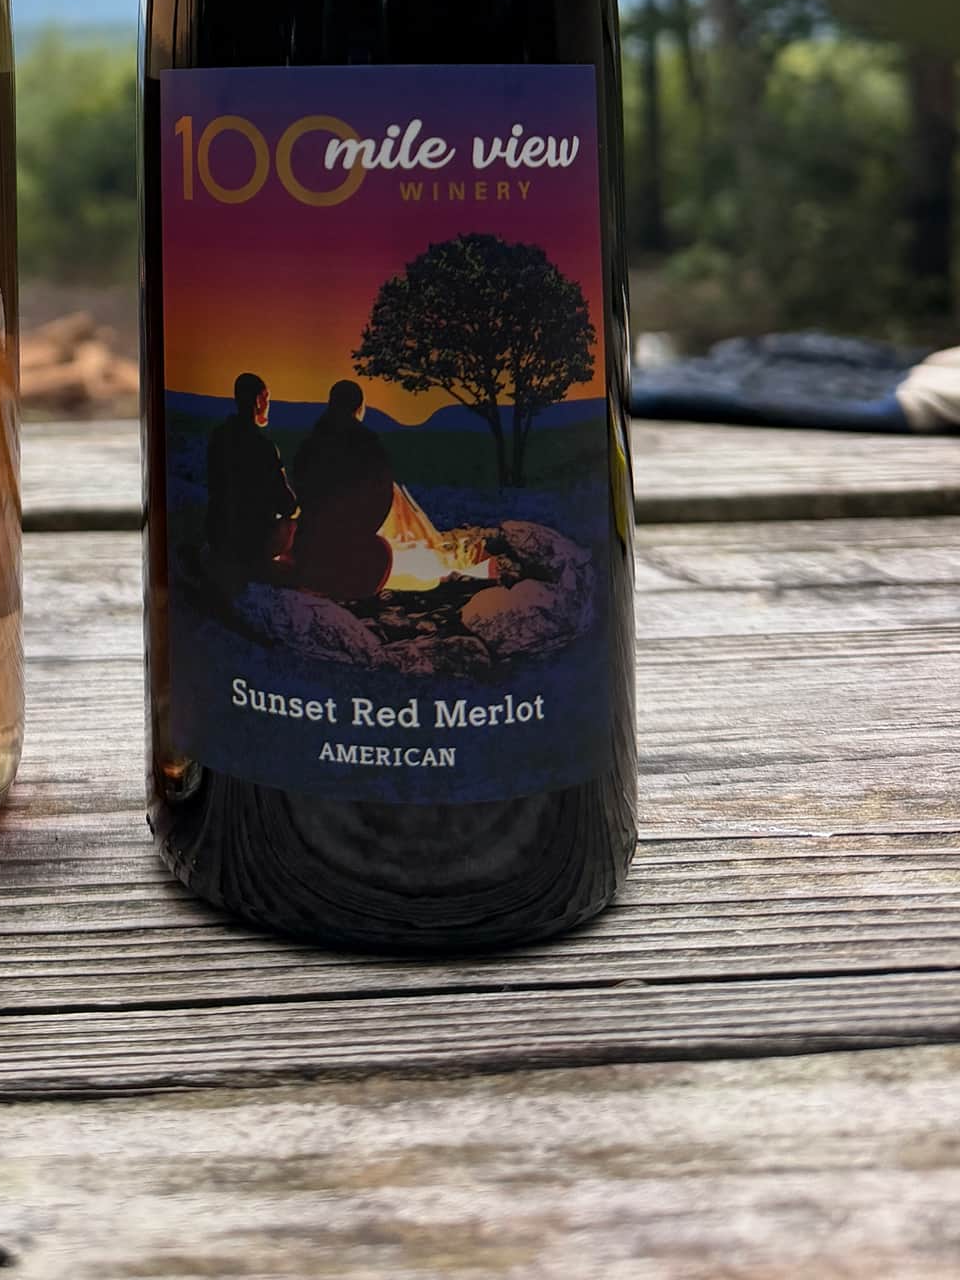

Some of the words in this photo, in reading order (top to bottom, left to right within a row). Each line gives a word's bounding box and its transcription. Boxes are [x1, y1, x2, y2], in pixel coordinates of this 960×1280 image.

[174, 115, 368, 207] 100
[324, 119, 456, 170] mile
[472, 124, 580, 168] view
[399, 181, 531, 201] WINERY
[232, 678, 337, 723] Sunset
[351, 698, 419, 728] Red
[434, 695, 544, 728] Merlot
[318, 742, 457, 767] AMERICAN
